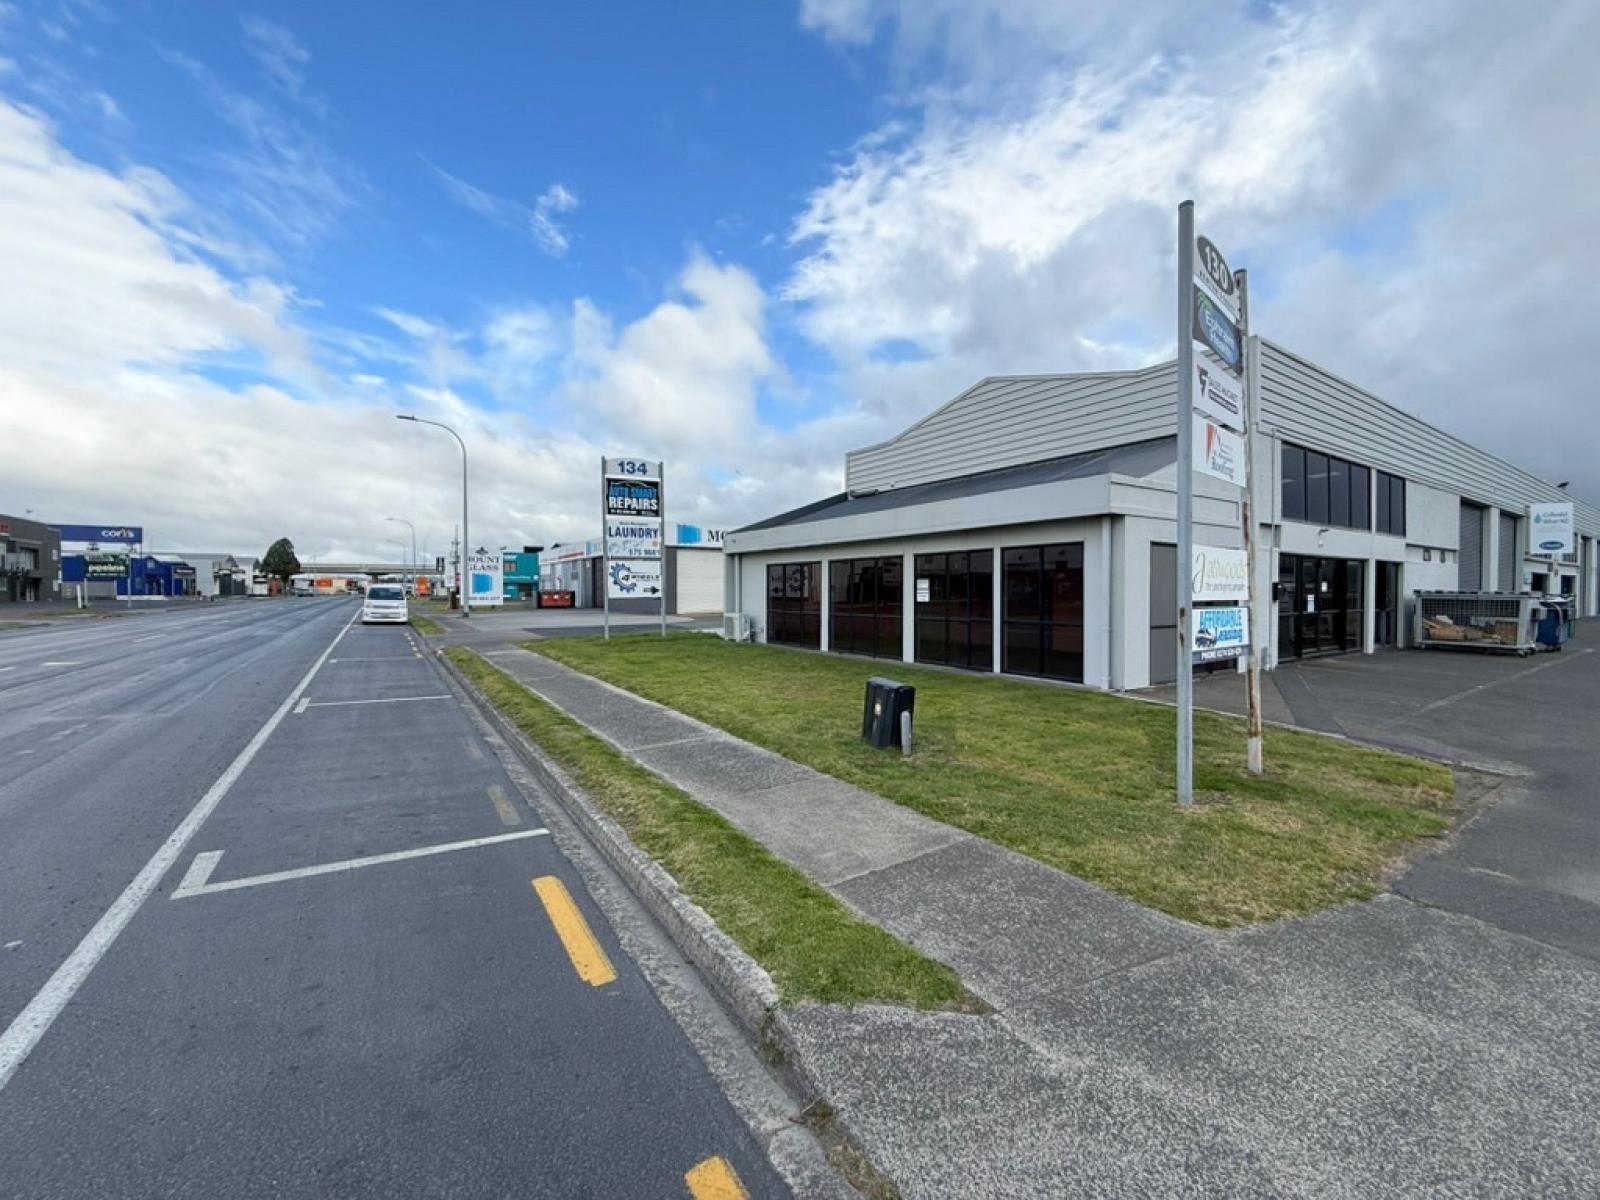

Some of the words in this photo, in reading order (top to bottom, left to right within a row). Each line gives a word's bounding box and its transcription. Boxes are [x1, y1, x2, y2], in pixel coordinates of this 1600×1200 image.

[1204, 246, 1228, 290] 130
[618, 460, 648, 475] 134
[609, 496, 657, 509] REPAIRS
[608, 526, 658, 539] LAUNDRY
